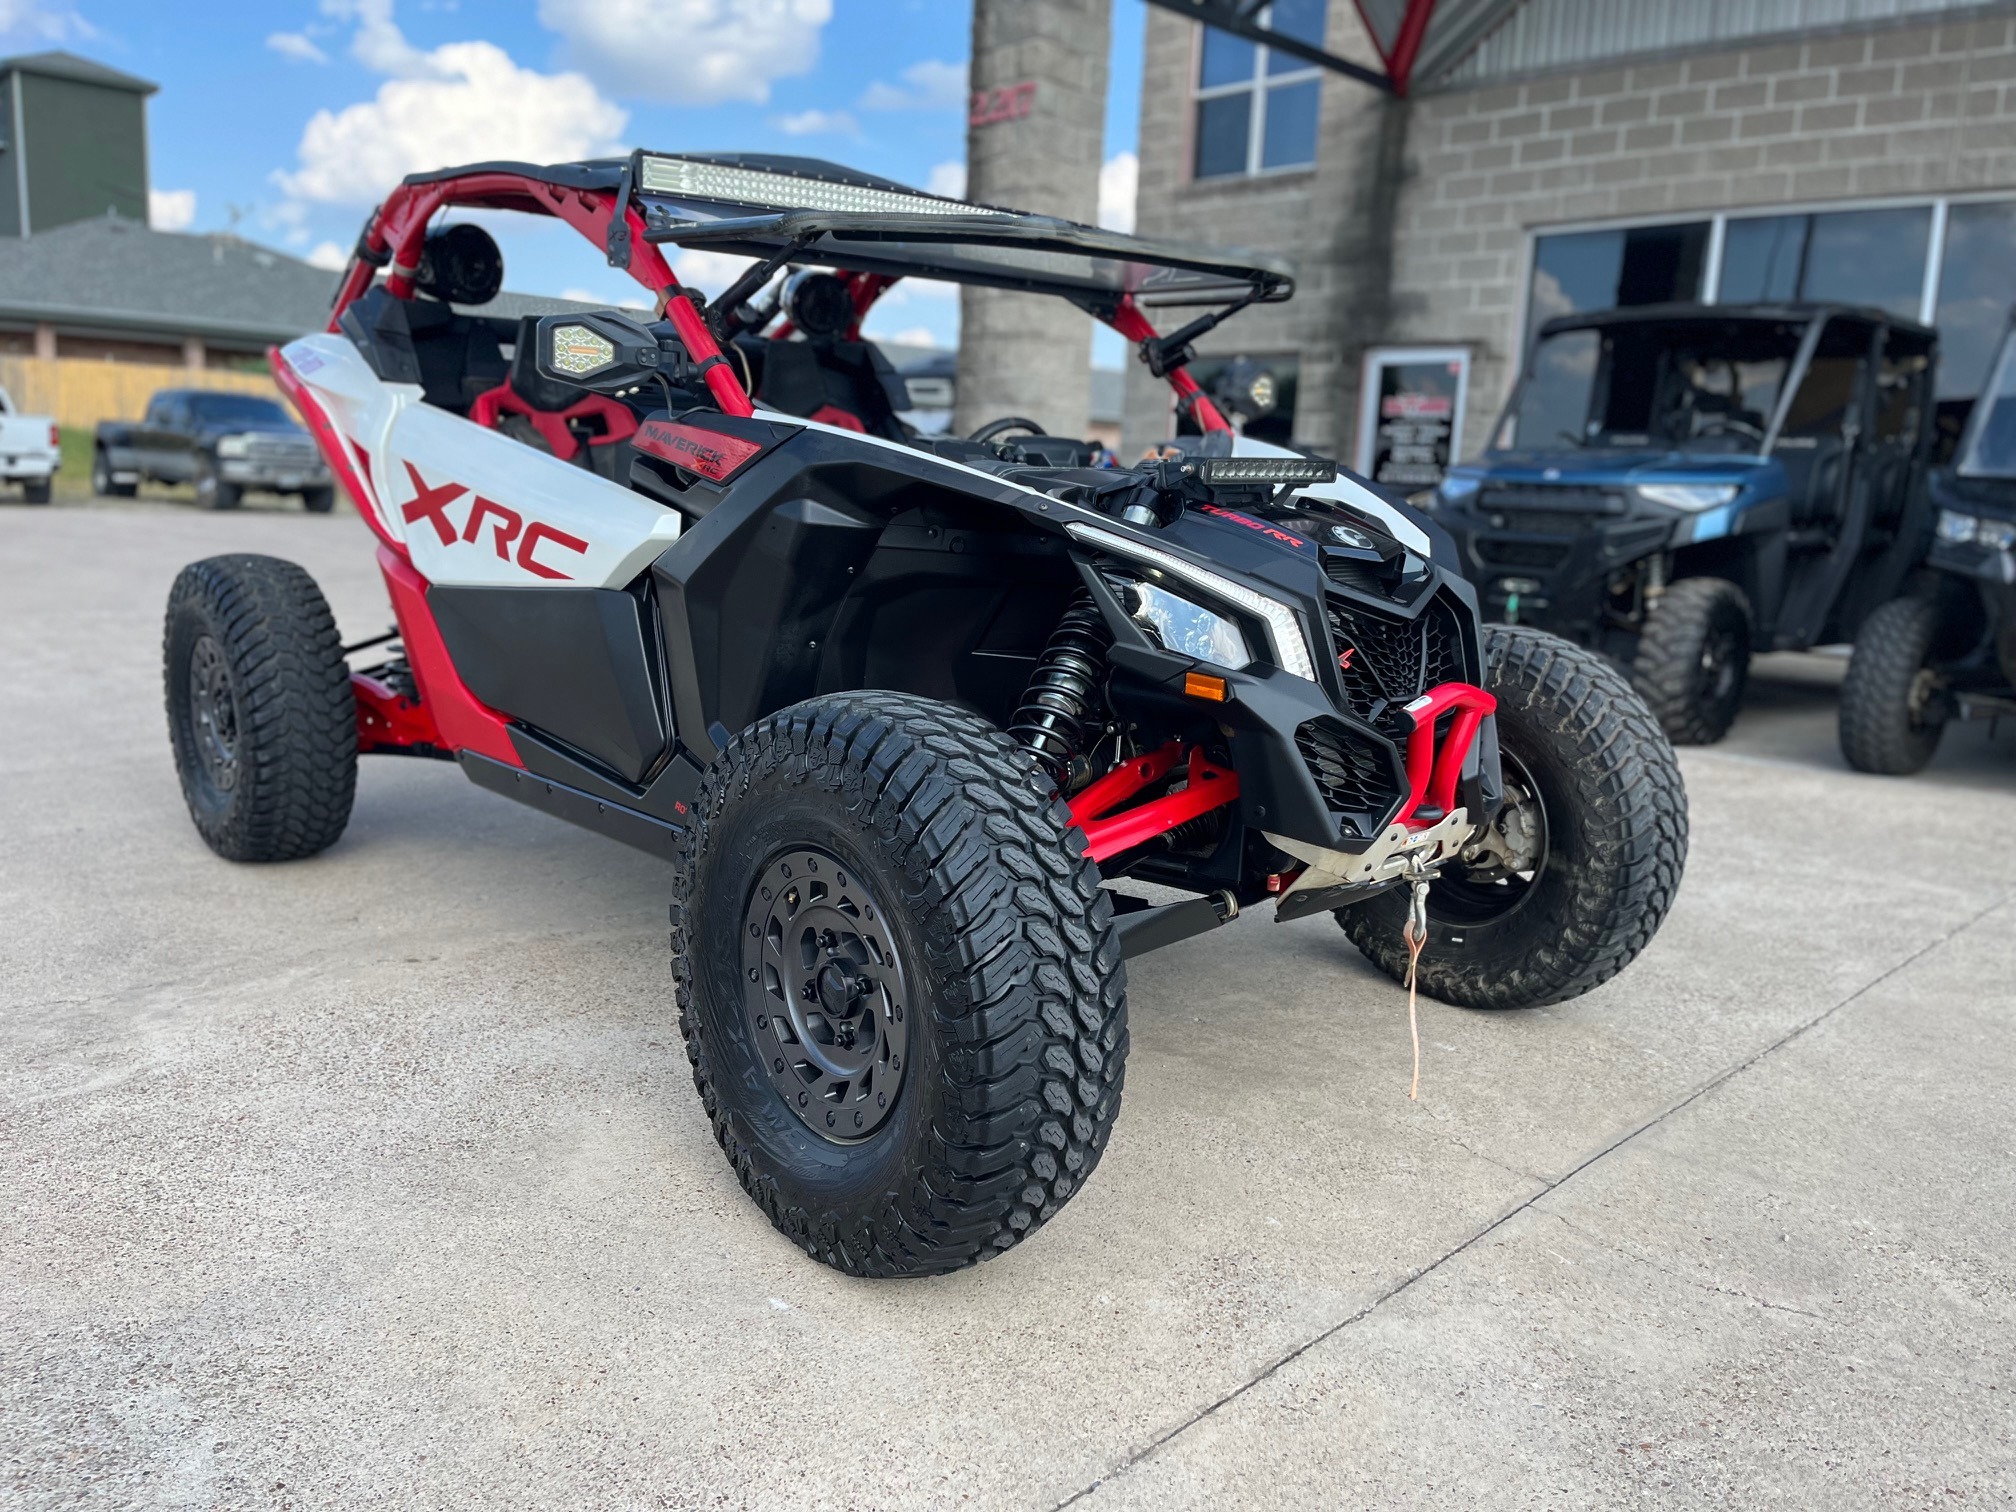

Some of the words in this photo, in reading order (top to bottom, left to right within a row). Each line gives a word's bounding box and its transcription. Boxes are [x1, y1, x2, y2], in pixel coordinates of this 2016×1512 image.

[608, 230, 627, 242] X3
[644, 423, 726, 466] MAVERICK
[690, 457, 720, 476] XRC
[401, 459, 589, 581] XRC
[1200, 503, 1265, 531] TURBO
[1263, 528, 1304, 548] RR
[674, 800, 688, 815] RO
